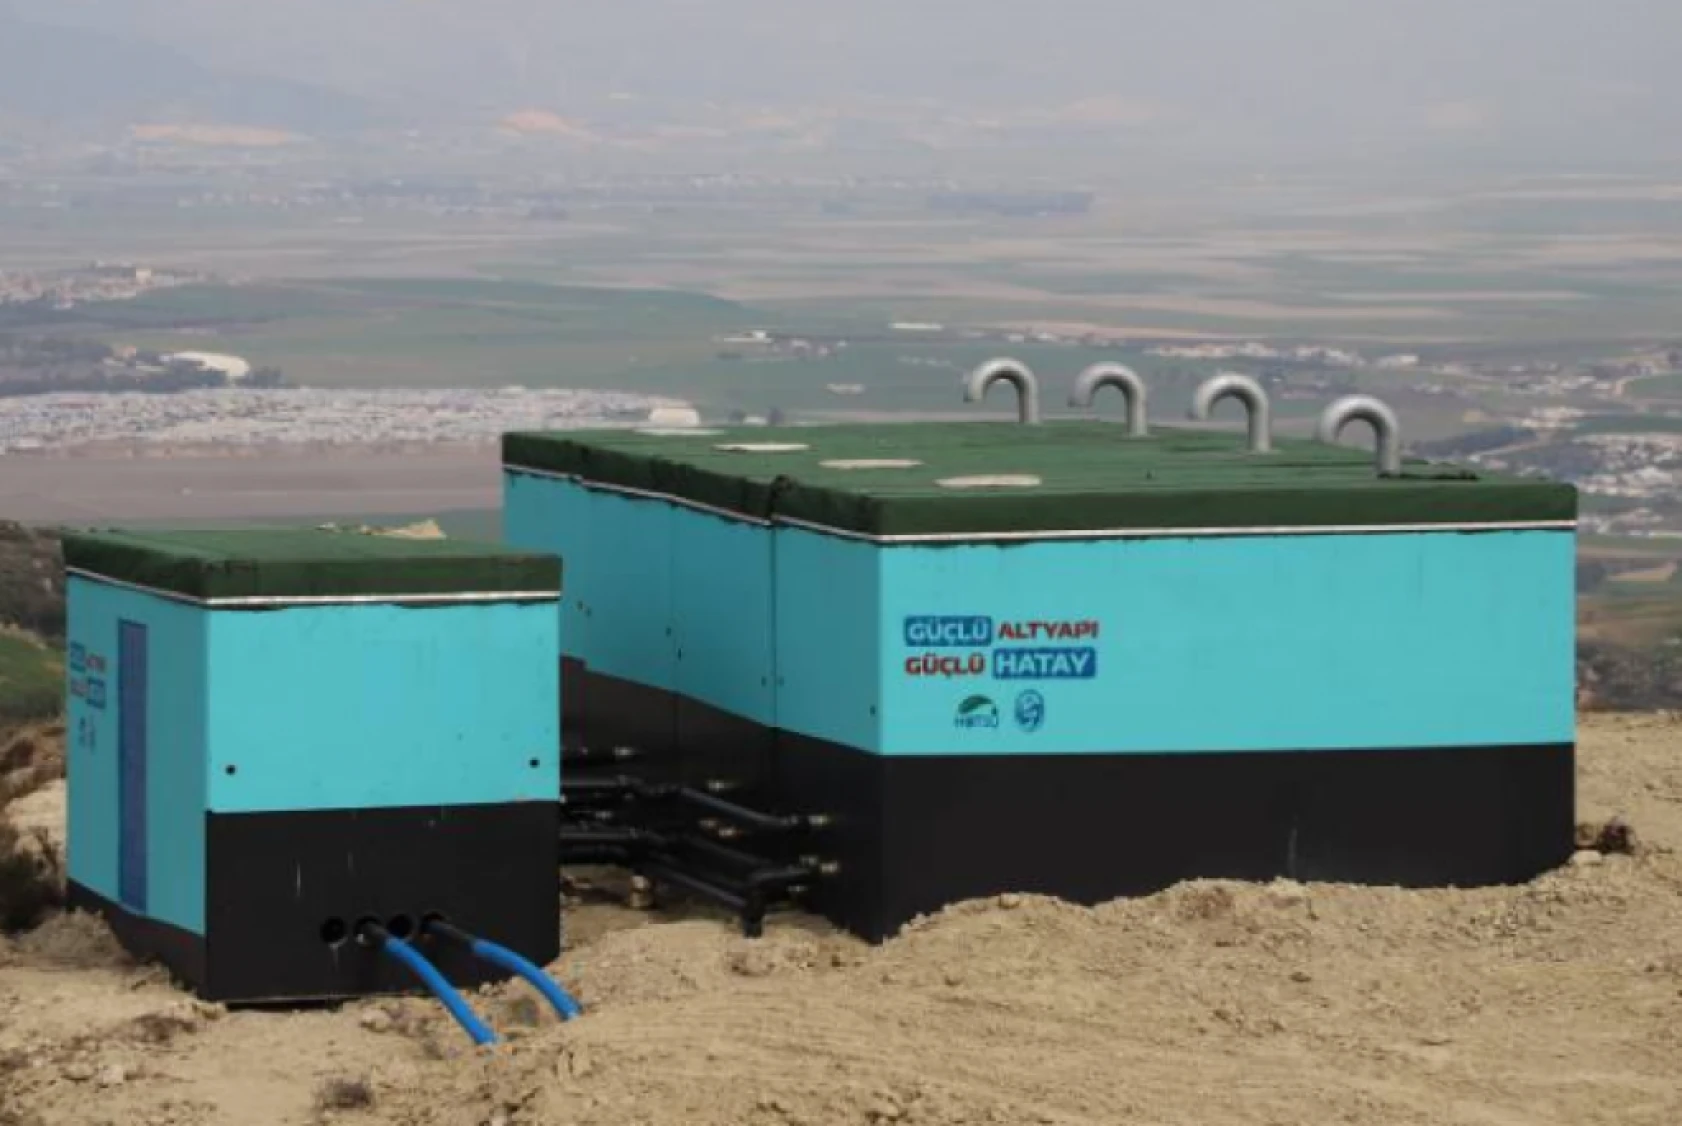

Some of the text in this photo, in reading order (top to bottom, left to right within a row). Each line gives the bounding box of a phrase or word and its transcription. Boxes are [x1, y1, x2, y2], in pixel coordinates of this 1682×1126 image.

[907, 618, 1099, 643] GÜÇLÜ ALTYAPI
[905, 652, 1089, 678] GÜÇLÜ HATAY
